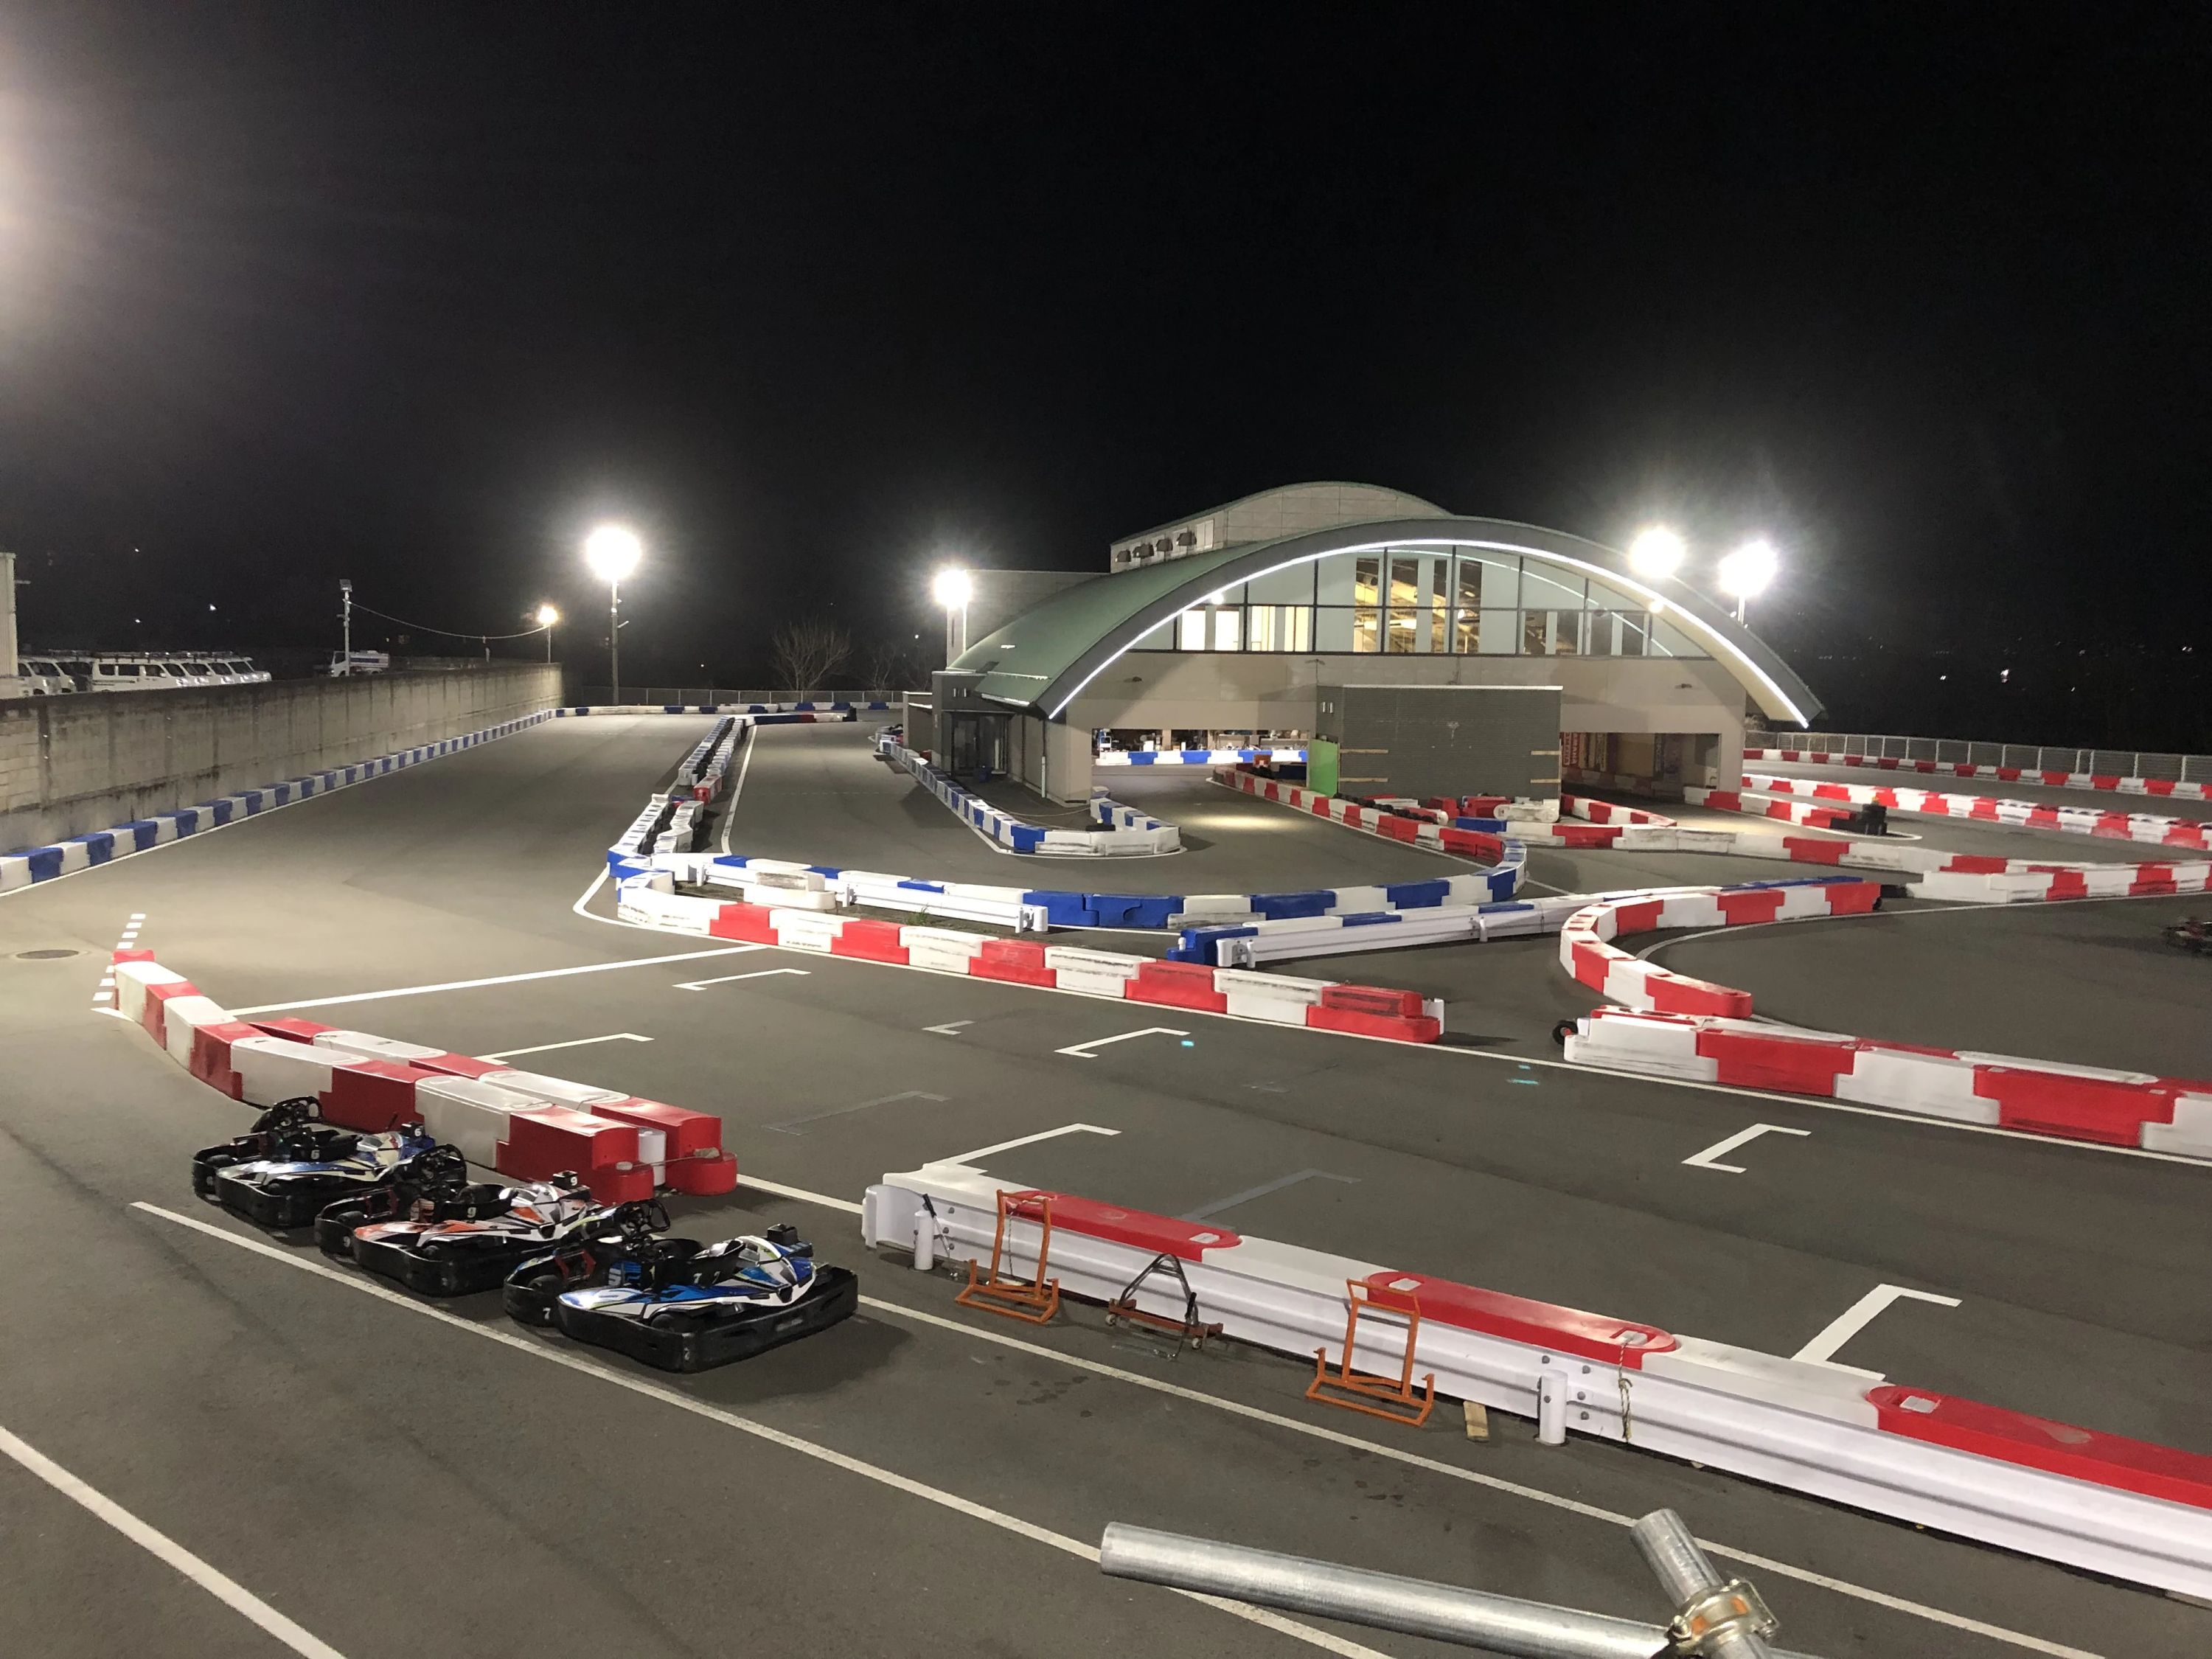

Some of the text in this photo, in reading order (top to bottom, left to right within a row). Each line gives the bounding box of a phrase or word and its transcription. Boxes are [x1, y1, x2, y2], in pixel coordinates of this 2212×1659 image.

[414, 1128, 422, 1136] 6
[311, 1150, 320, 1159] 6
[571, 1176, 577, 1186] 9
[467, 1207, 476, 1217] 9
[344, 1237, 350, 1248] 9
[693, 1273, 702, 1284] 7
[543, 1307, 551, 1319] 7
